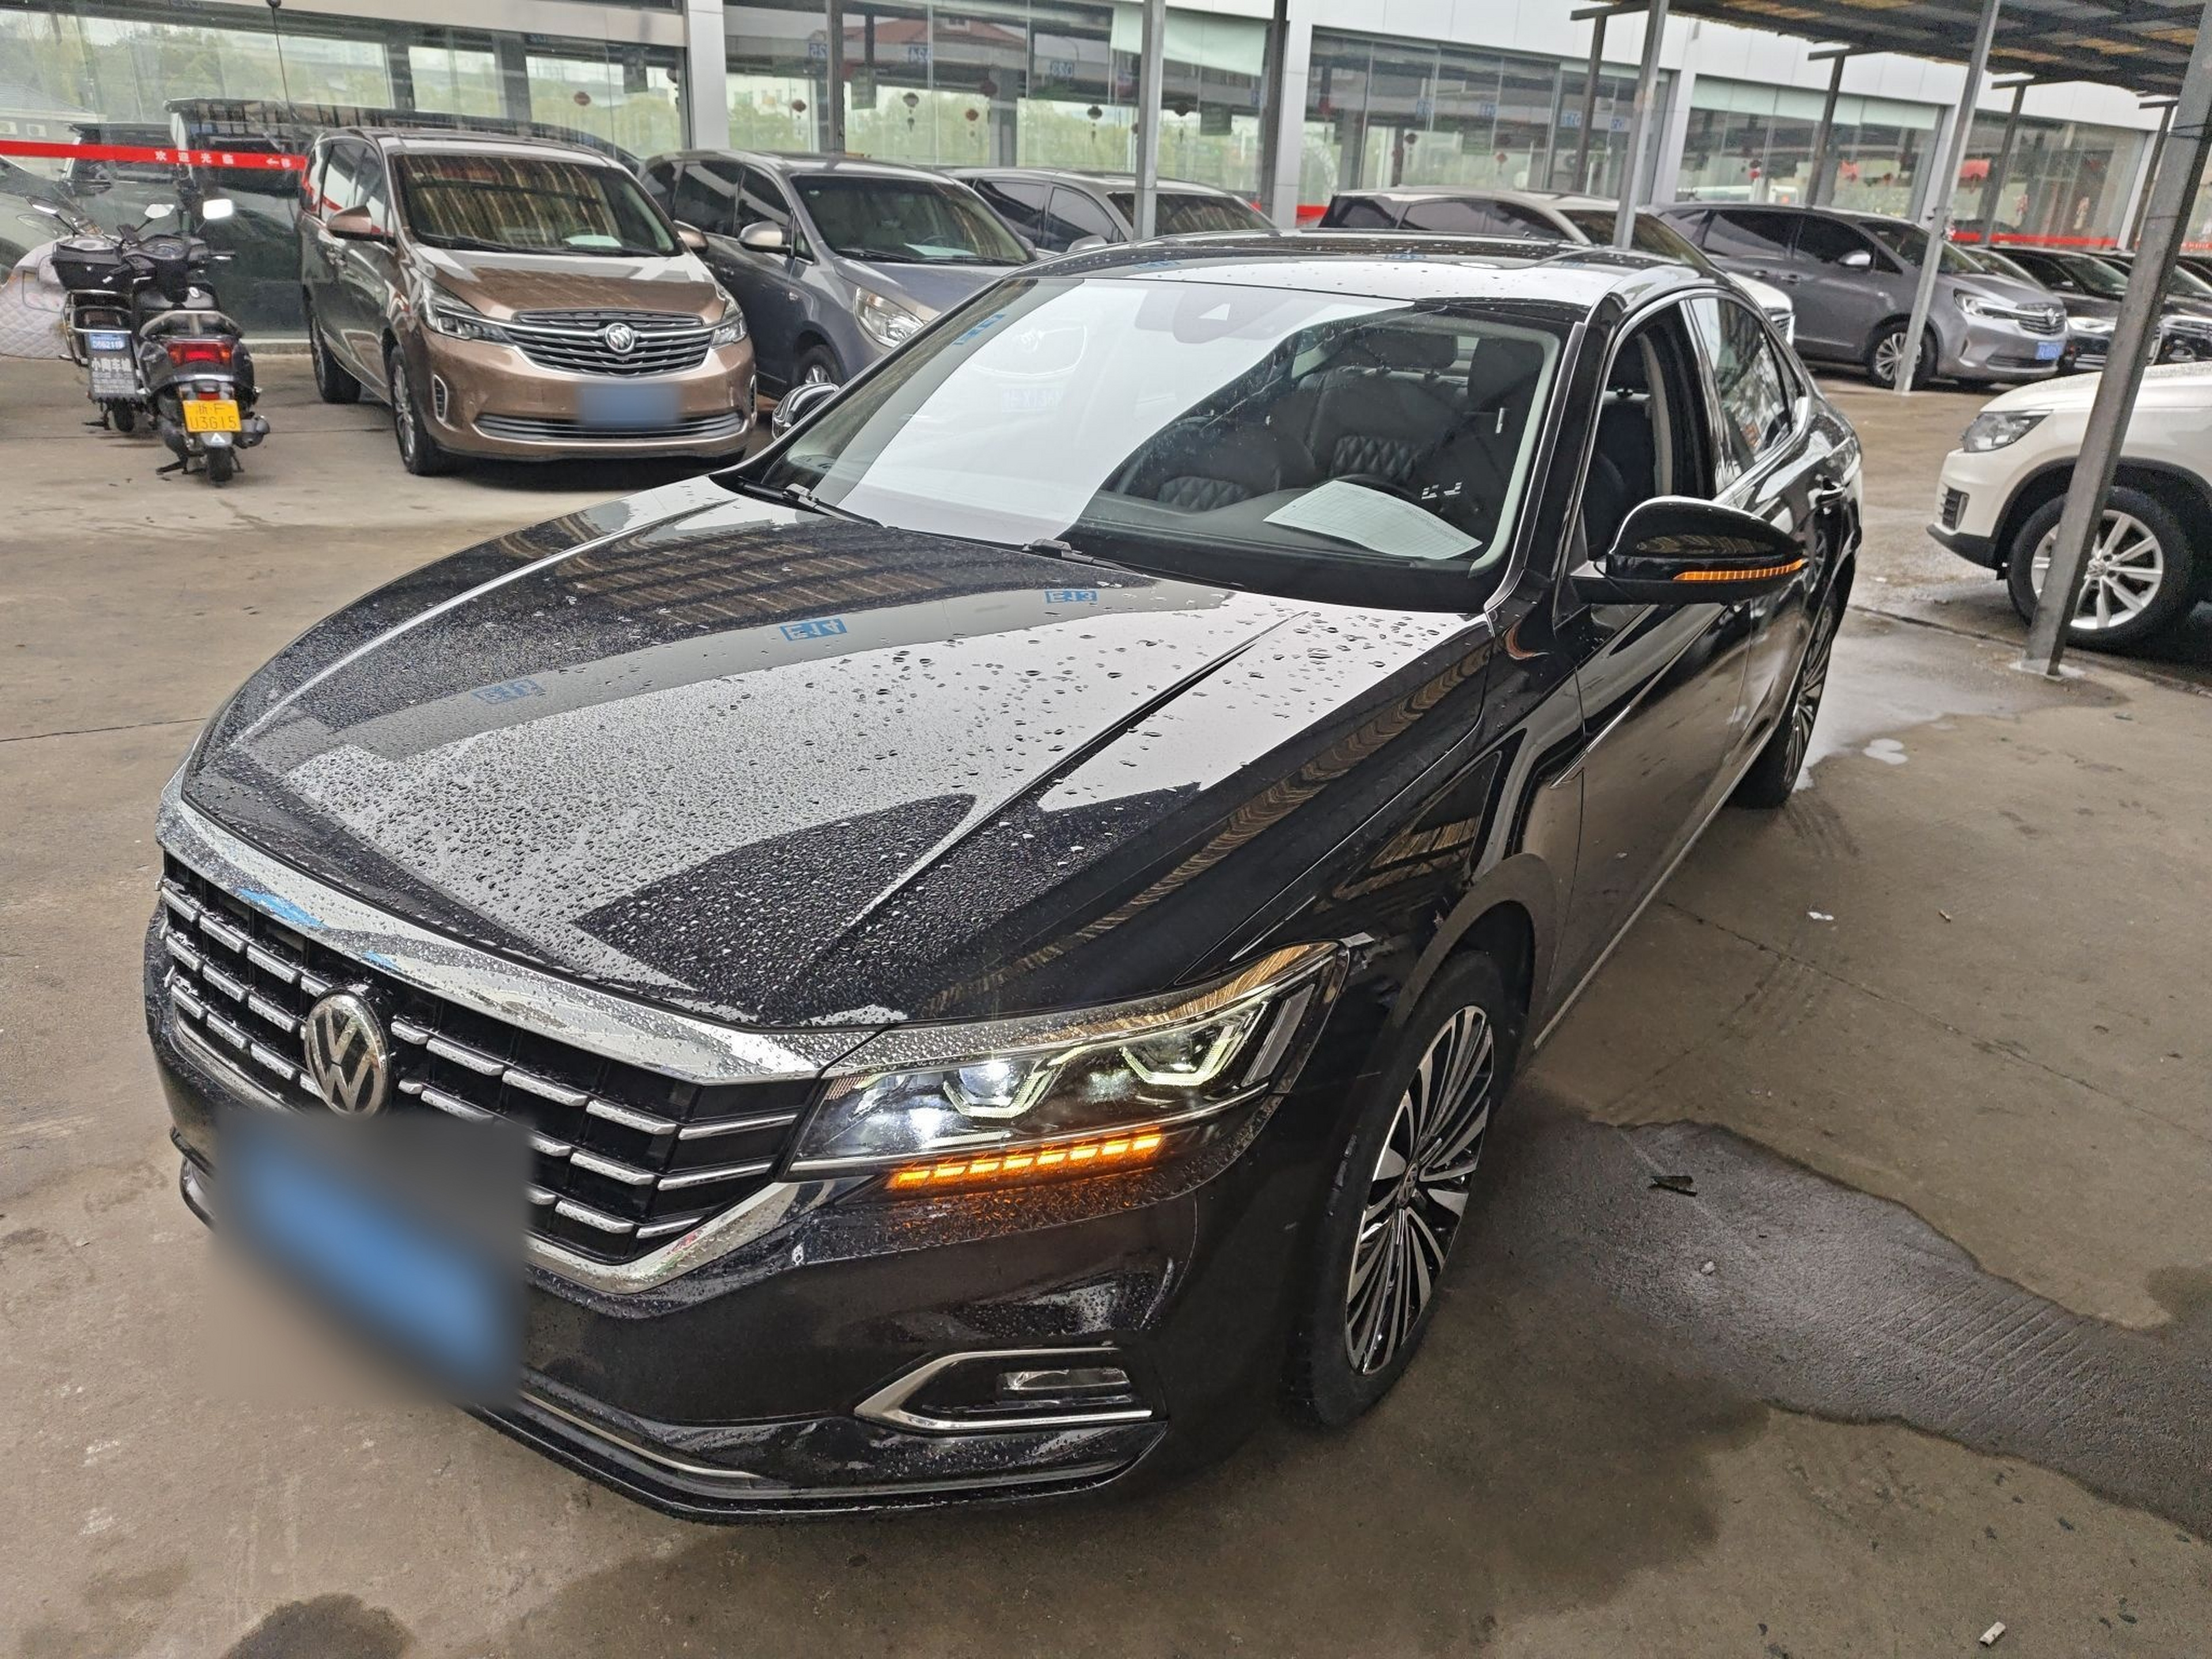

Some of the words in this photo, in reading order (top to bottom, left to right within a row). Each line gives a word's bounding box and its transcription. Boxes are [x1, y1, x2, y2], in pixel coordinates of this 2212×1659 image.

[155, 150, 235, 165] 欢迎光临
[190, 416, 237, 430] U3G15
[308, 997, 388, 1114] VW
